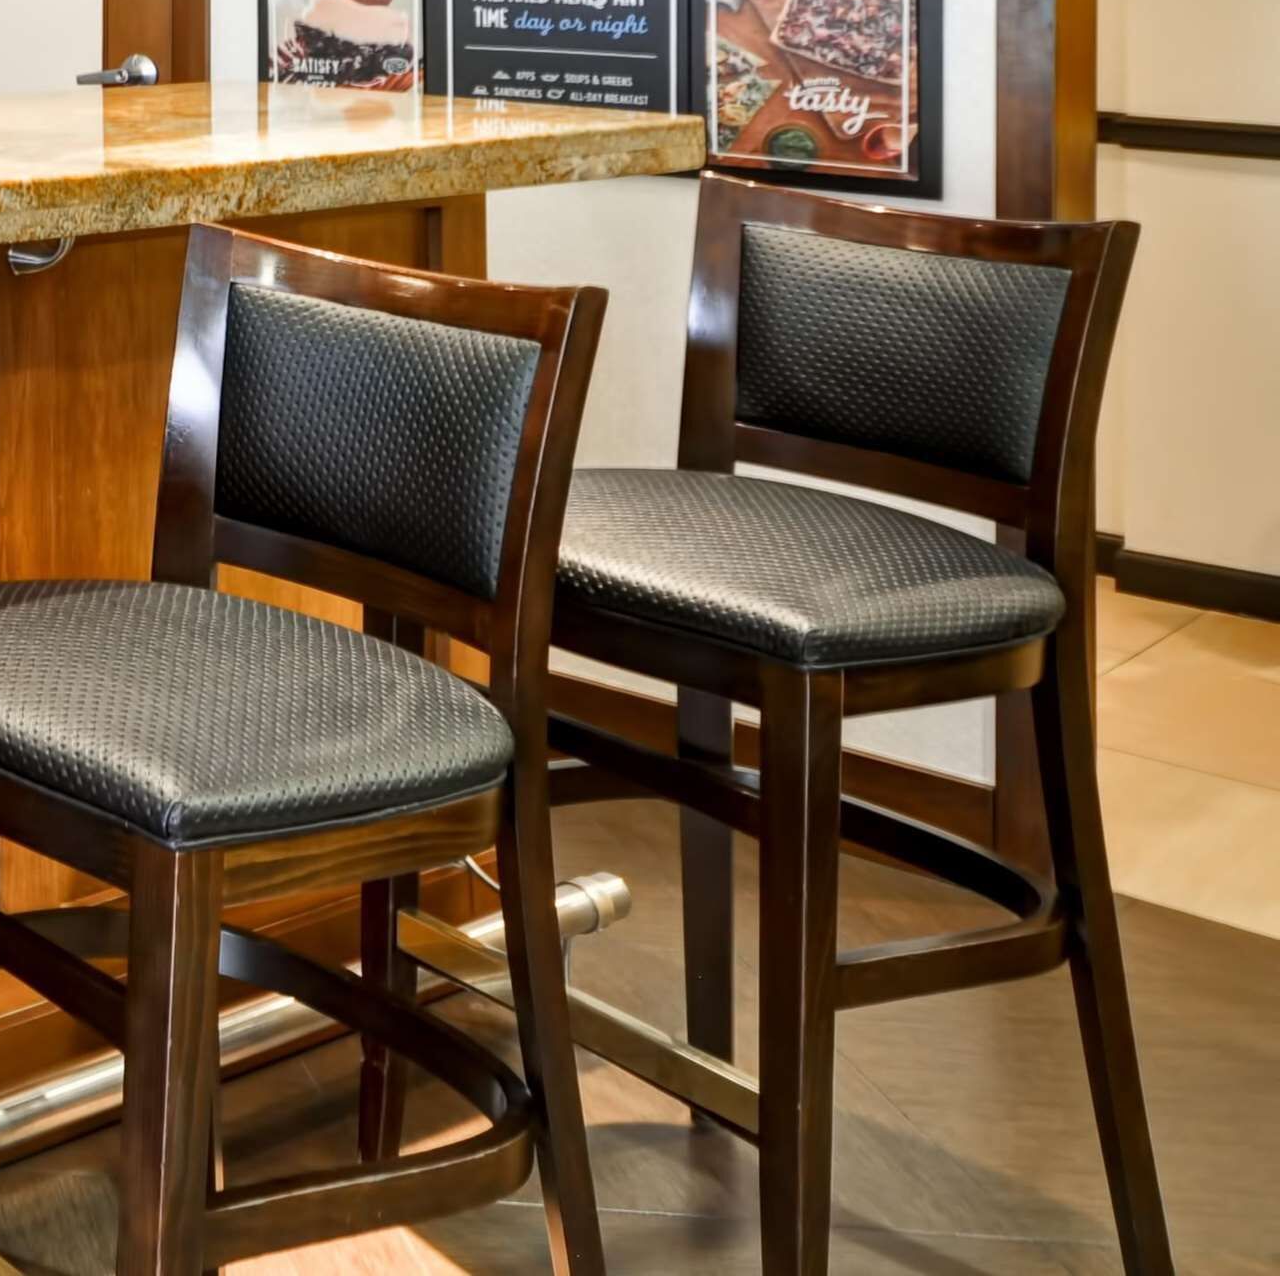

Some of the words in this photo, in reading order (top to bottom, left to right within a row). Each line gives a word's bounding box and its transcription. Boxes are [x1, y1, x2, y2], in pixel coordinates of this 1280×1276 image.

[473, 6, 509, 28] TIME
[513, 10, 554, 36] day
[559, 17, 587, 32] or
[591, 13, 648, 39] night
[783, 85, 886, 135] tasty
